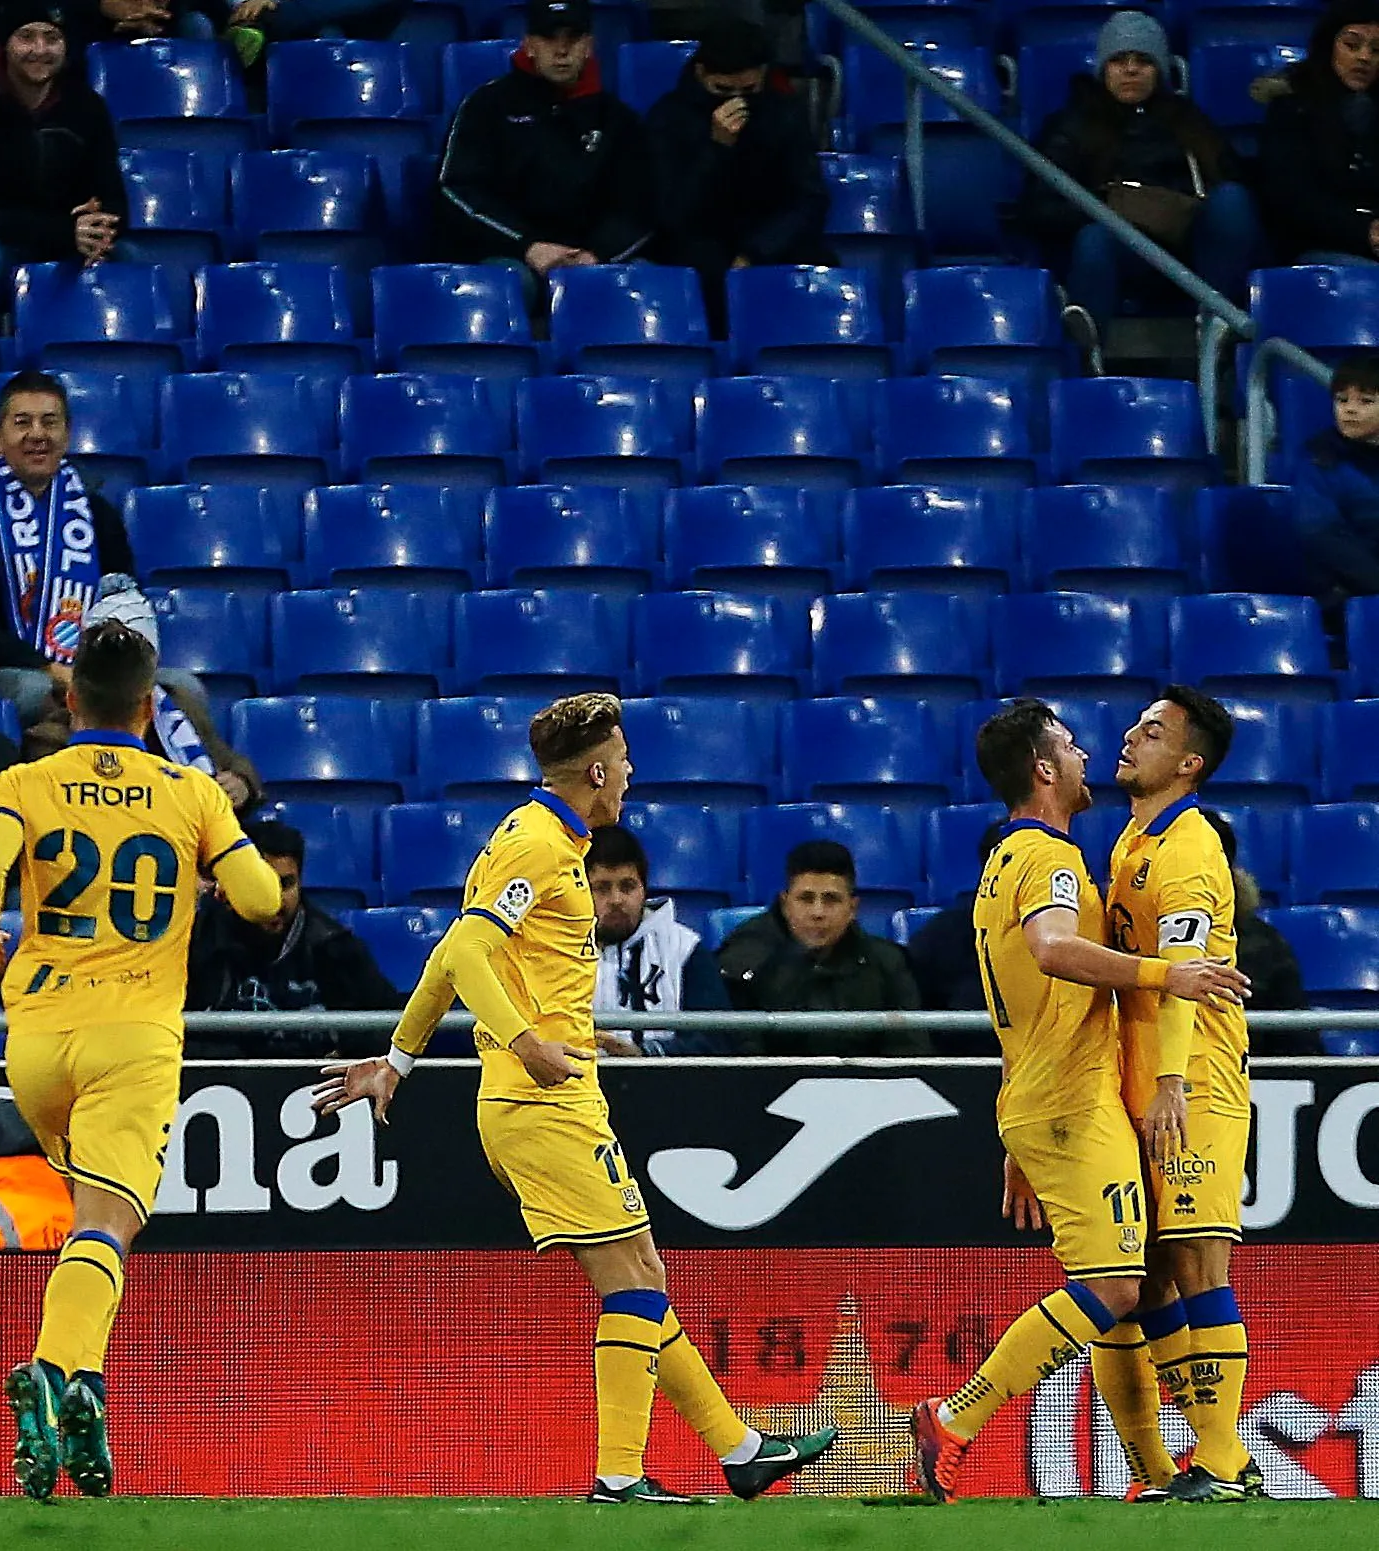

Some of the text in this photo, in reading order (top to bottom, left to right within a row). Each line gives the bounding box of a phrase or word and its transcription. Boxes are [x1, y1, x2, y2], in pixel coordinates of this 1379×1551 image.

[61, 782, 152, 809] TROPI
[33, 828, 179, 942] 20
[1102, 1181, 1141, 1224] 11
